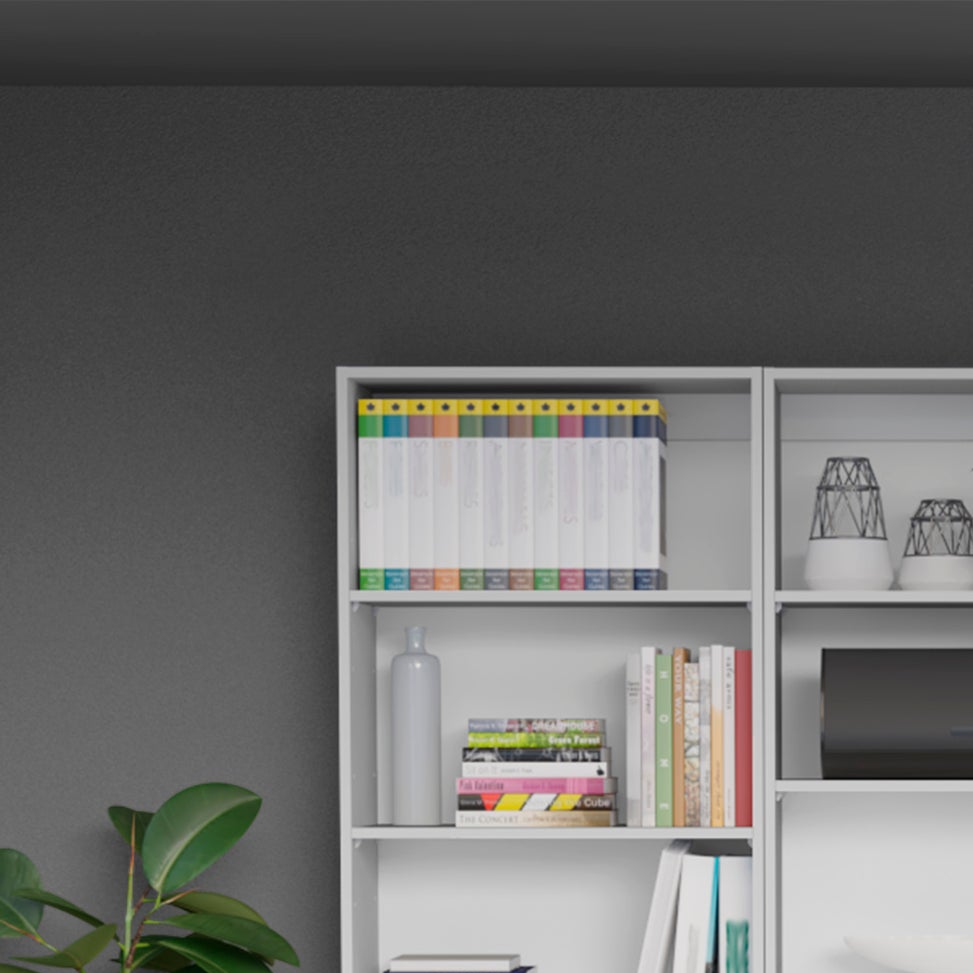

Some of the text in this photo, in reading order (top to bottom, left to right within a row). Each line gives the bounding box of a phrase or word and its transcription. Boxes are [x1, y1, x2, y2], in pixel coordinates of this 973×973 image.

[674, 654, 684, 726] YOUR WAY
[584, 797, 611, 807] Cube
